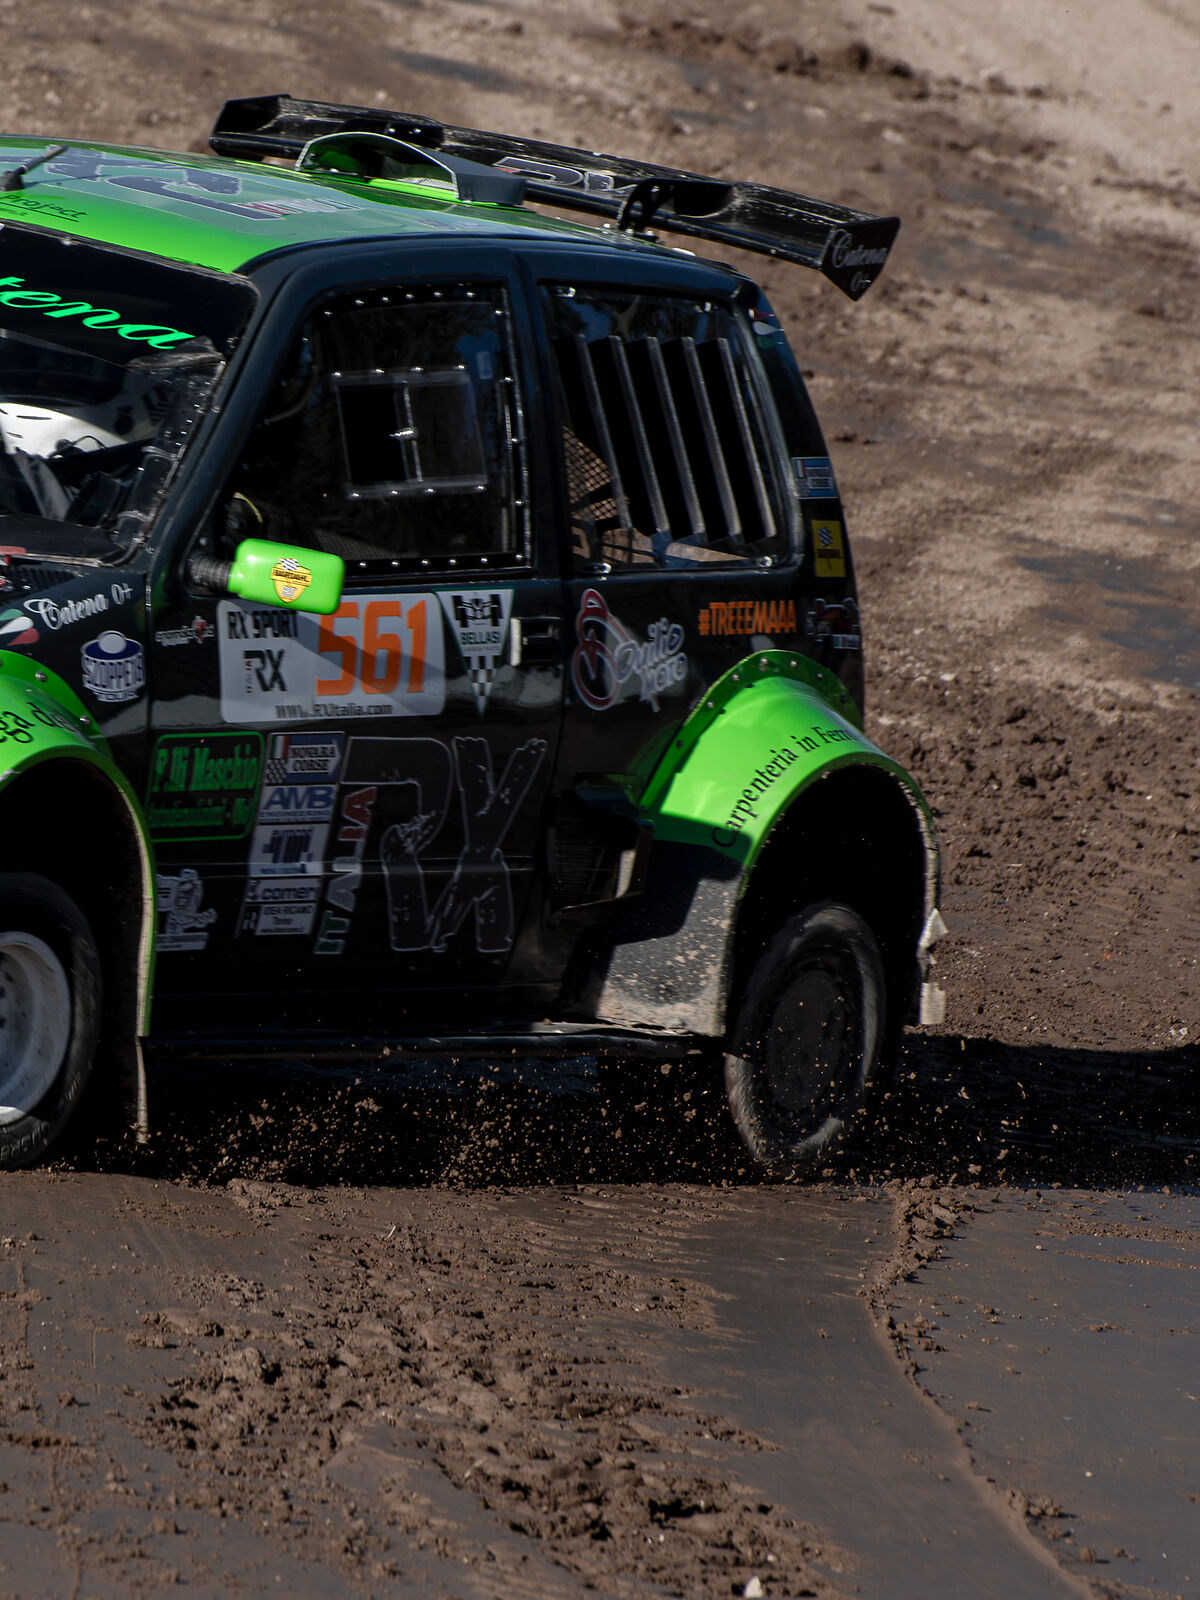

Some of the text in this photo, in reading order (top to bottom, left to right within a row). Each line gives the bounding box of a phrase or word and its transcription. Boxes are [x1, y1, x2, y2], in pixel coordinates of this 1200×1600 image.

[23, 593, 110, 631] Catena
[227, 611, 248, 640] RX
[252, 608, 298, 640] SPORT
[698, 599, 798, 637] #TREEEMAAA
[316, 600, 426, 696] 561
[460, 630, 500, 645] BELLASI
[243, 648, 288, 692] RX
[291, 759, 330, 772] CORSE
[265, 786, 334, 810] AMB
[711, 747, 799, 848] Carpenteria
[790, 735, 821, 753] in
[340, 736, 547, 953] RX
[312, 786, 377, 956] ITALIA
